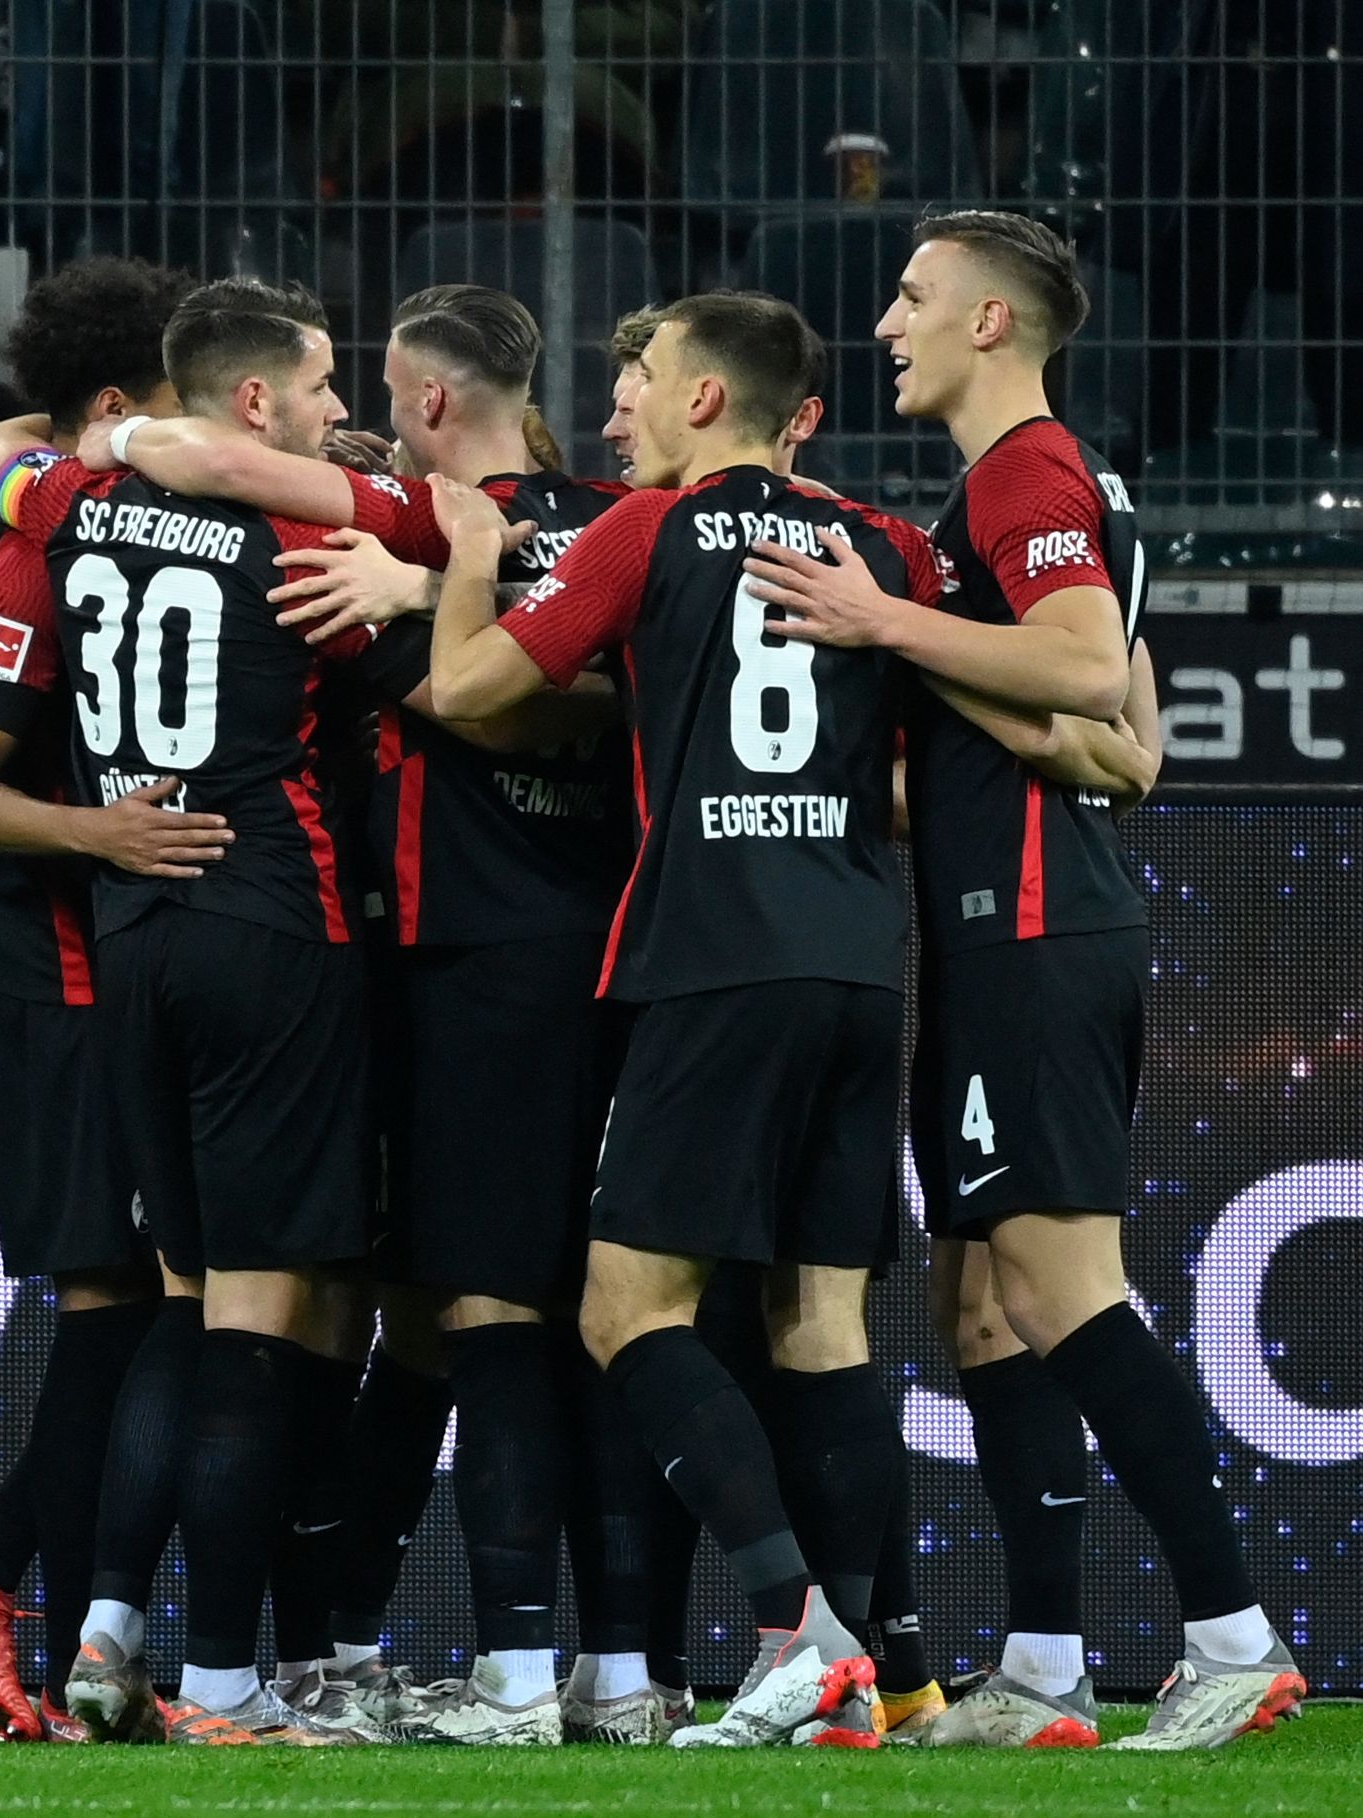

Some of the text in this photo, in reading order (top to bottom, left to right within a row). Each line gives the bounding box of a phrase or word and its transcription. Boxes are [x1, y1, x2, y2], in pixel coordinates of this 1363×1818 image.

[76, 499, 246, 564] SC FREIBURG
[694, 512, 737, 551] SC
[1026, 531, 1089, 570] ROSE
[65, 553, 224, 770] 30
[730, 571, 819, 773] 8
[700, 795, 849, 840] EGGESTEIN
[961, 1073, 996, 1155] 4
